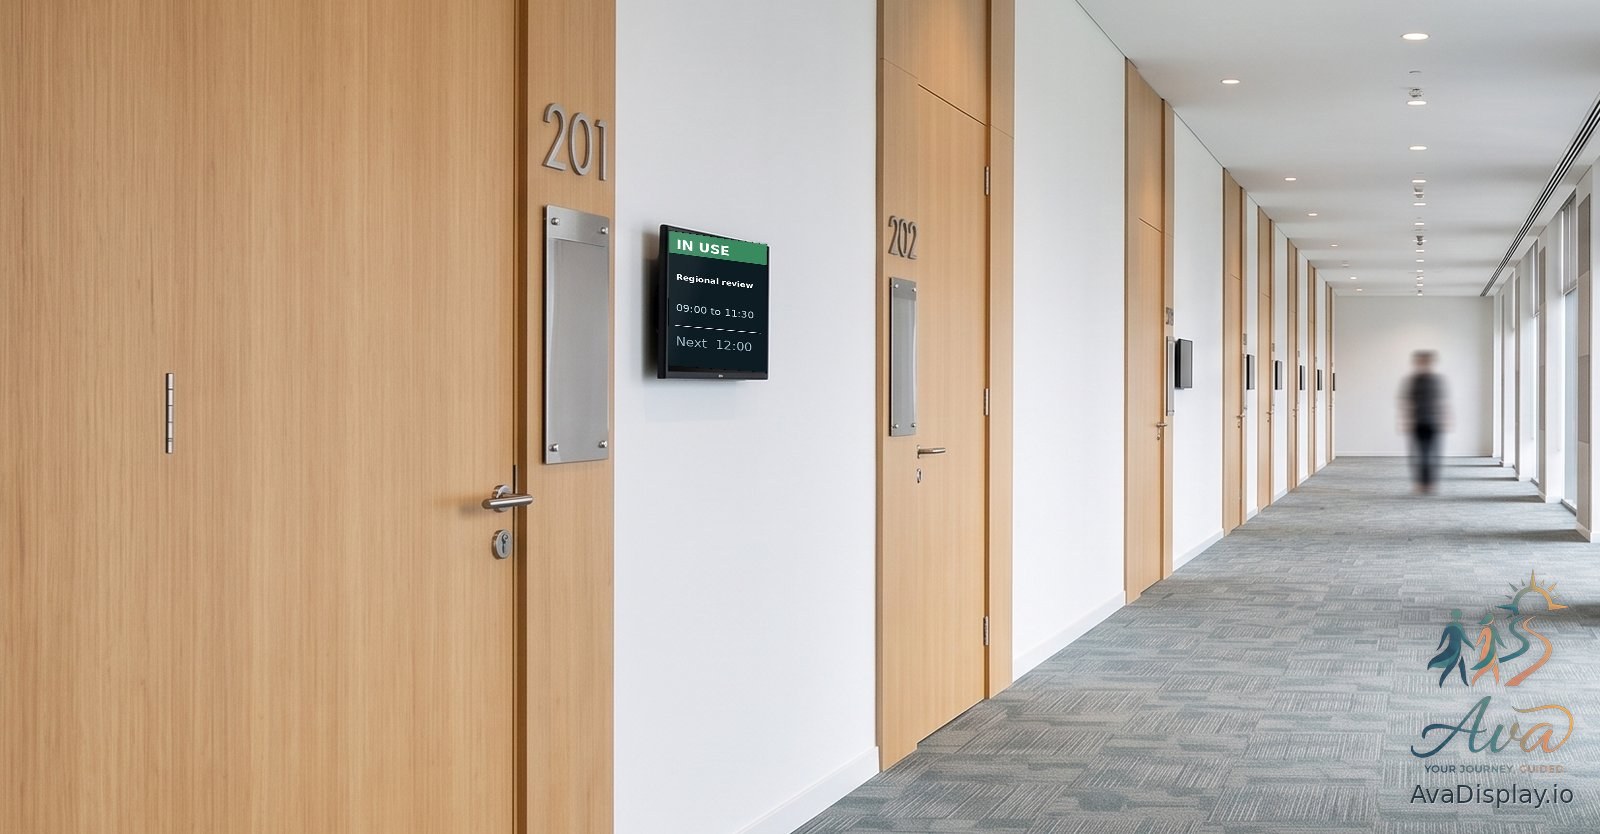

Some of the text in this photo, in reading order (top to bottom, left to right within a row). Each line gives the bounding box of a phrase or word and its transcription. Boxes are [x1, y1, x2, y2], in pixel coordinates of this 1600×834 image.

[541, 103, 608, 181] 201
[888, 215, 918, 260] 202
[677, 239, 730, 256] IN USE
[676, 273, 754, 289] Regional review
[676, 303, 754, 319] 09:00 to 11:30
[676, 335, 752, 352] Next 12:00
